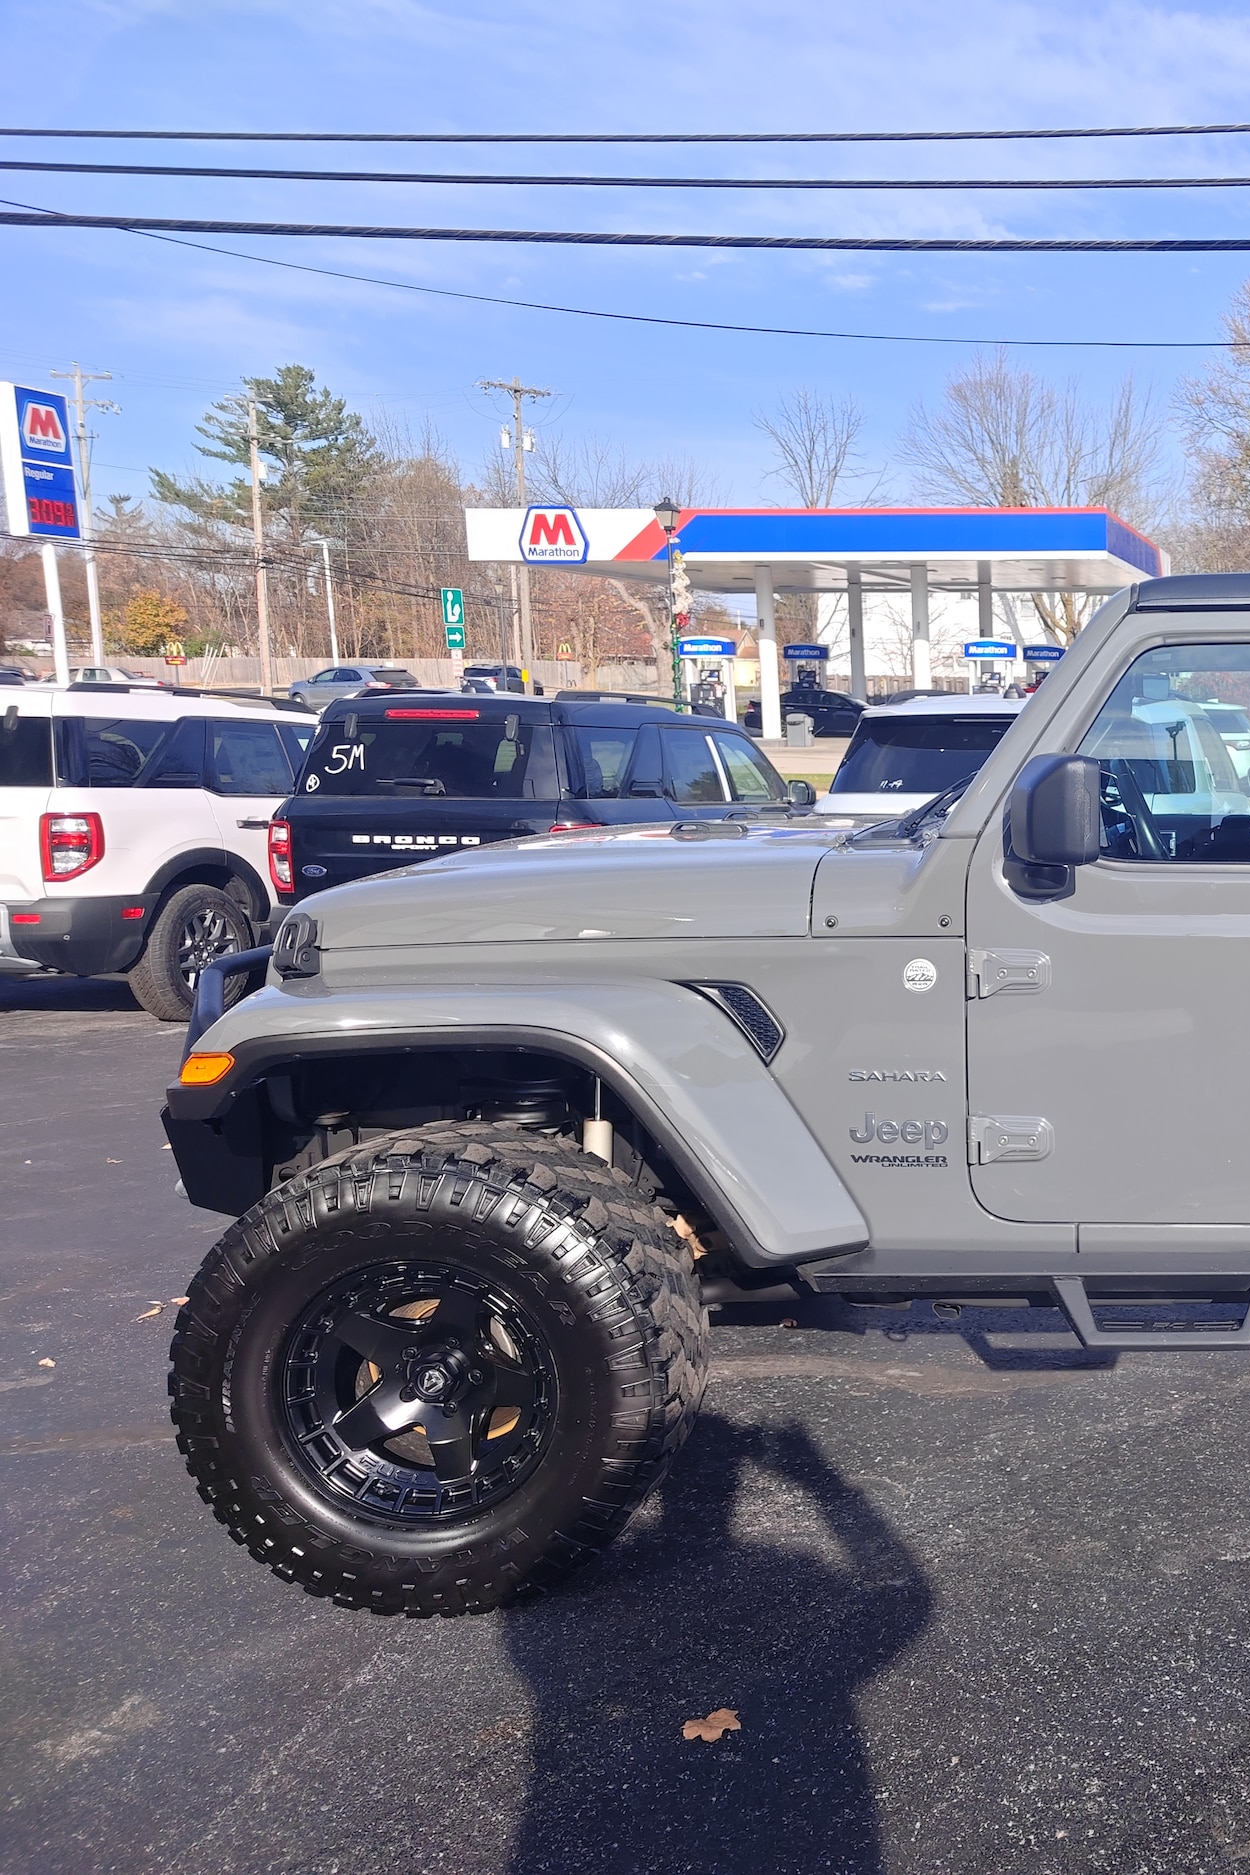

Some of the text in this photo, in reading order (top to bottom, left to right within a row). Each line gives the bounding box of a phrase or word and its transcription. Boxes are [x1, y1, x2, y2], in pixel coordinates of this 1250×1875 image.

[29, 407, 61, 440] M
[29, 435, 62, 449] Marathon
[25, 466, 54, 481] Regular
[529, 513, 576, 545] M
[528, 547, 579, 557] Marathon
[683, 643, 723, 653] Marathon
[787, 648, 820, 657] Marathon
[968, 645, 1008, 655] Marathon
[1026, 649, 1060, 658] Marathon
[352, 834, 480, 845] BRONCO
[848, 1069, 947, 1082] SAHARA
[849, 1111, 949, 1150] Jeep
[850, 1154, 948, 1164] WRANGLER
